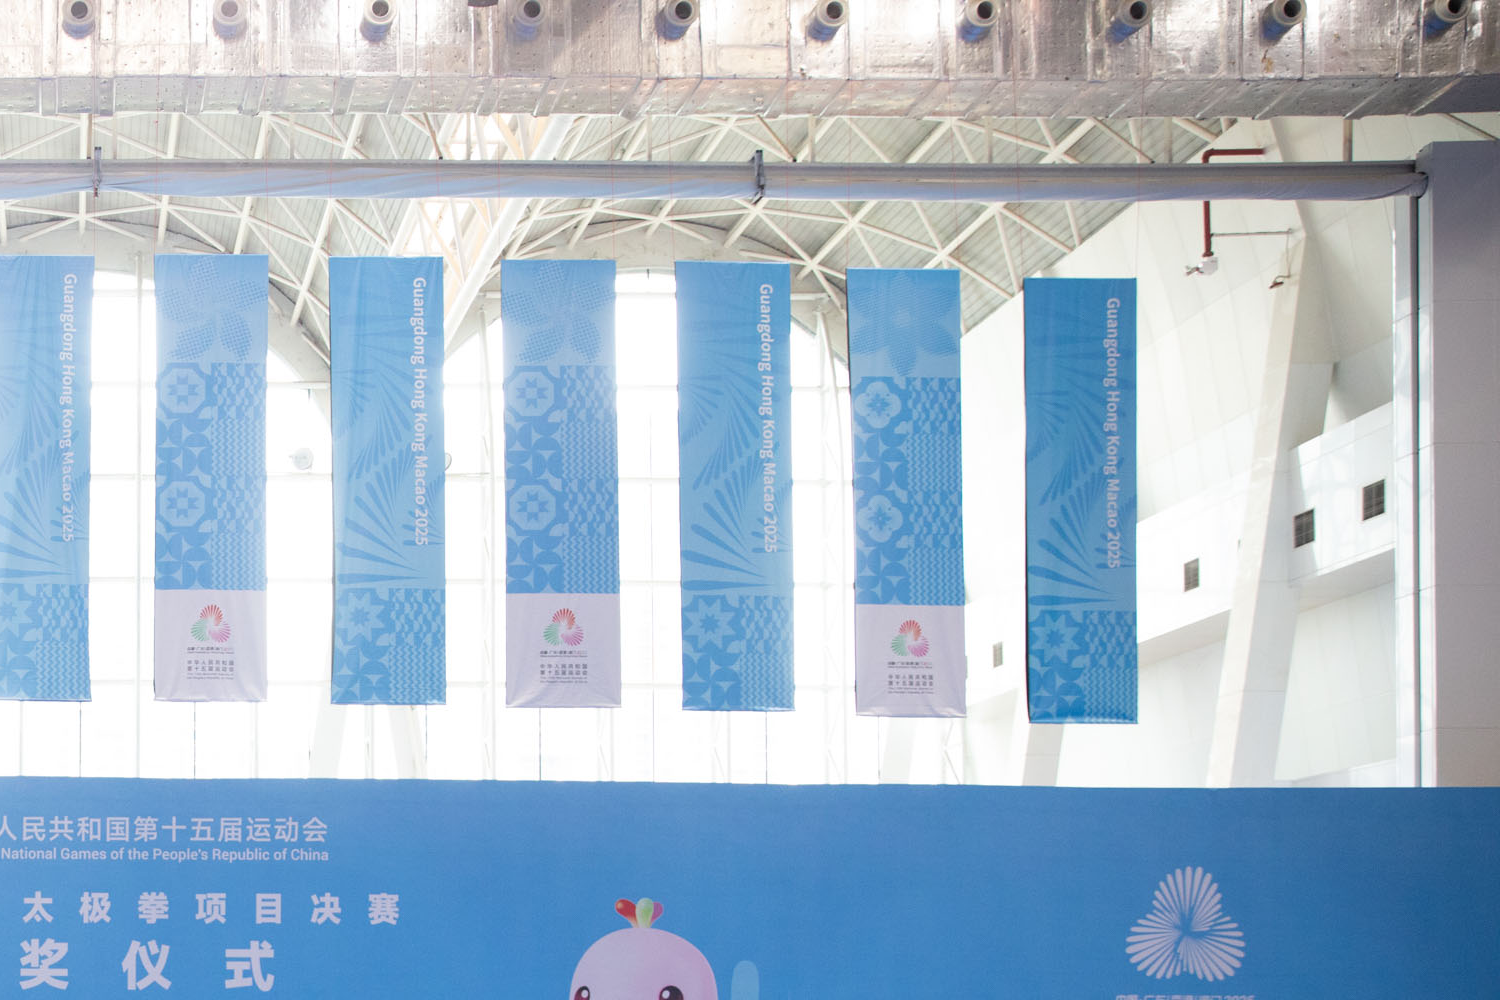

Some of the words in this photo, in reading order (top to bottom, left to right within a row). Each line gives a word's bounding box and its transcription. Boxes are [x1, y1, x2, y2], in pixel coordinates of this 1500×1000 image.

[60, 274, 77, 360] Guangdong
[410, 277, 427, 364] Guangdong
[757, 284, 774, 371] Guangdong
[1103, 299, 1121, 387] Guangdong
[60, 365, 76, 405] Hong
[411, 369, 428, 409] Hong
[758, 375, 775, 415] Hong
[60, 410, 76, 448] Kong
[1103, 391, 1120, 431] Hong
[411, 413, 428, 451] Kong
[760, 420, 777, 459] Kong
[1104, 436, 1120, 475] Kong
[62, 452, 75, 500] Macao
[415, 456, 429, 504] Macao
[763, 462, 777, 511] Macao
[62, 505, 76, 542] 2025
[1107, 479, 1120, 528] Macao
[415, 508, 429, 545] 2025
[763, 516, 778, 553] 2025
[1106, 532, 1120, 568] 2025
[1, 848, 57, 860] National
[61, 848, 106, 860] Games
[110, 848, 125, 860] of
[128, 848, 149, 860] the
[153, 848, 208, 863] People's
[213, 849, 270, 863] Republic
[274, 849, 288, 861] of
[291, 849, 329, 861] China
